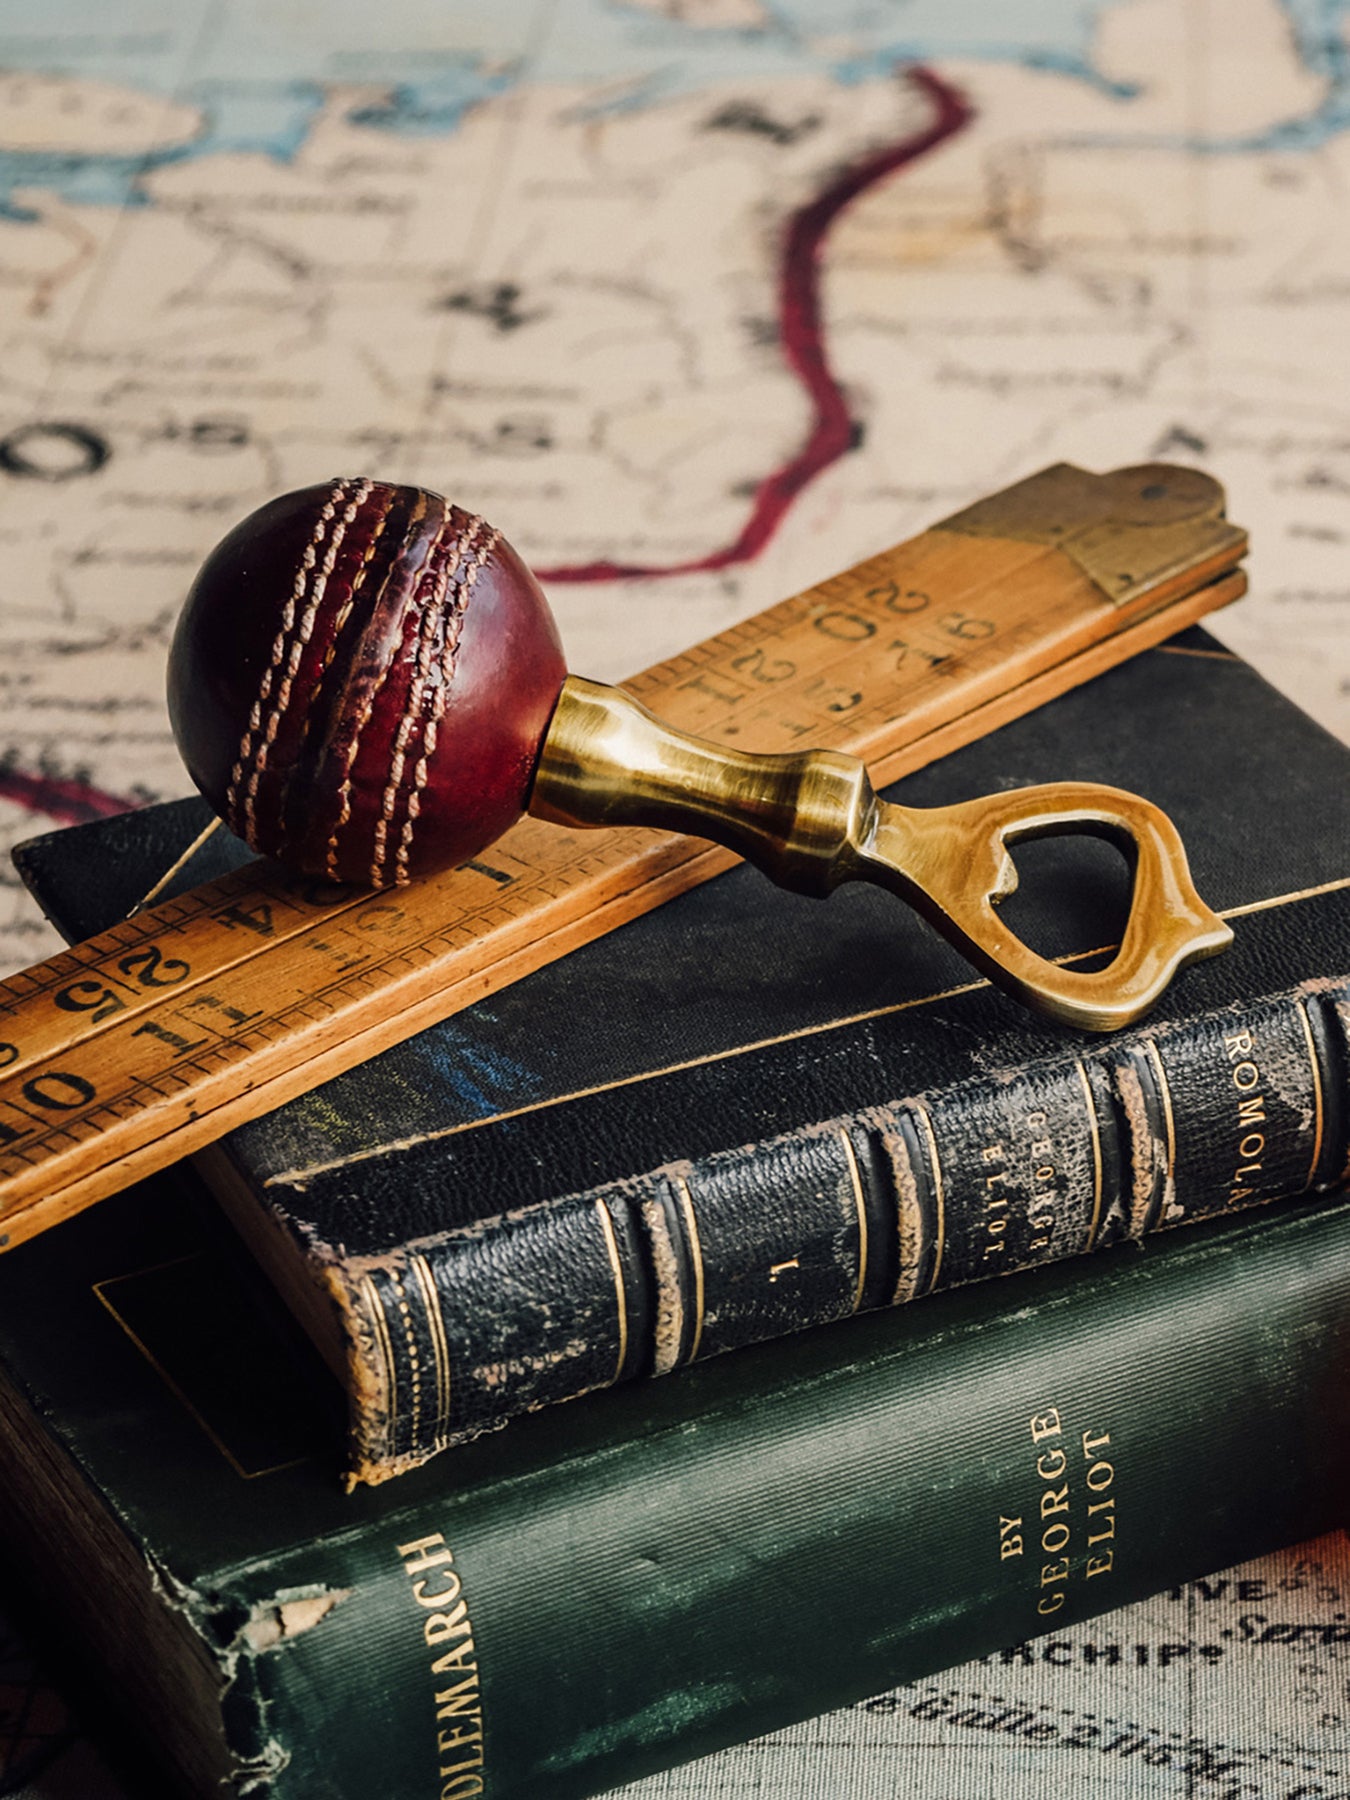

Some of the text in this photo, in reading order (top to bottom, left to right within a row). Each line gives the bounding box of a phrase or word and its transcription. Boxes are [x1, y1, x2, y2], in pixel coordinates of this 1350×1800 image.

[813, 579, 931, 642] 20
[676, 648, 797, 705] 21
[53, 945, 191, 1024] 25
[130, 994, 264, 1058] 11
[1224, 1029, 1267, 1205] ROMOLA
[998, 1515, 1024, 1562] BY
[1029, 1407, 1071, 1616] GEORGE
[1081, 1429, 1115, 1581] ELIOT
[397, 1532, 485, 1800] DLEMARCH
